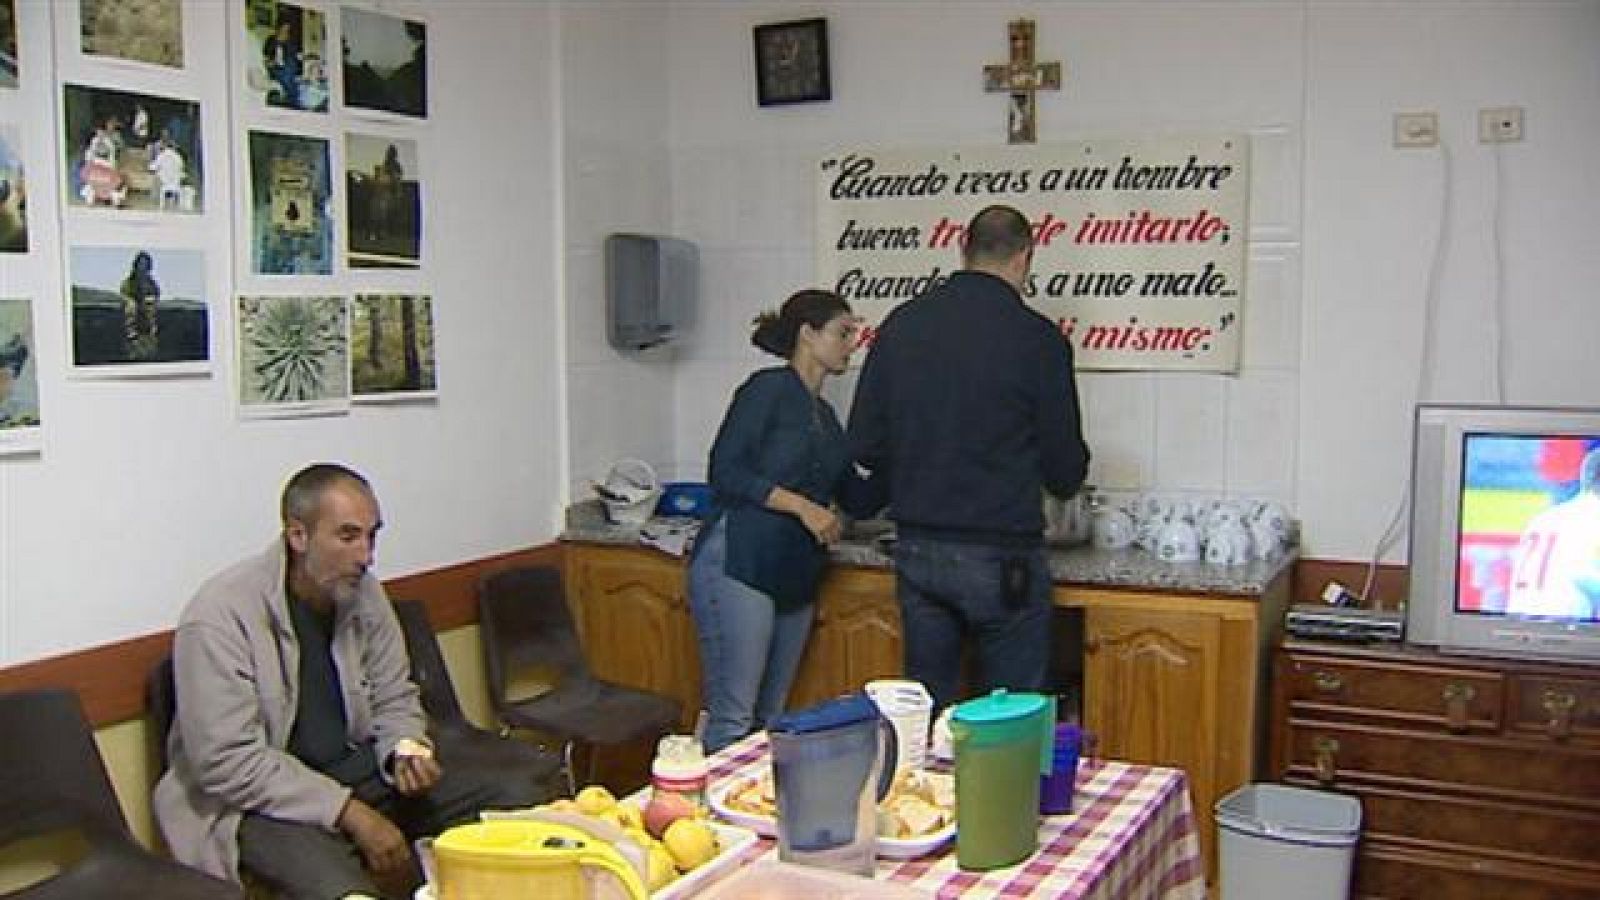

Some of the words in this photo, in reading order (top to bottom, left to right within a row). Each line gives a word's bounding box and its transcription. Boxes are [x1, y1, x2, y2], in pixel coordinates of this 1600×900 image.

[954, 170, 1031, 194] veas
[1039, 168, 1063, 191] a
[1065, 167, 1108, 191] un
[1113, 155, 1232, 191] hombre
[1046, 272, 1070, 296] a
[1072, 272, 1134, 297] uno
